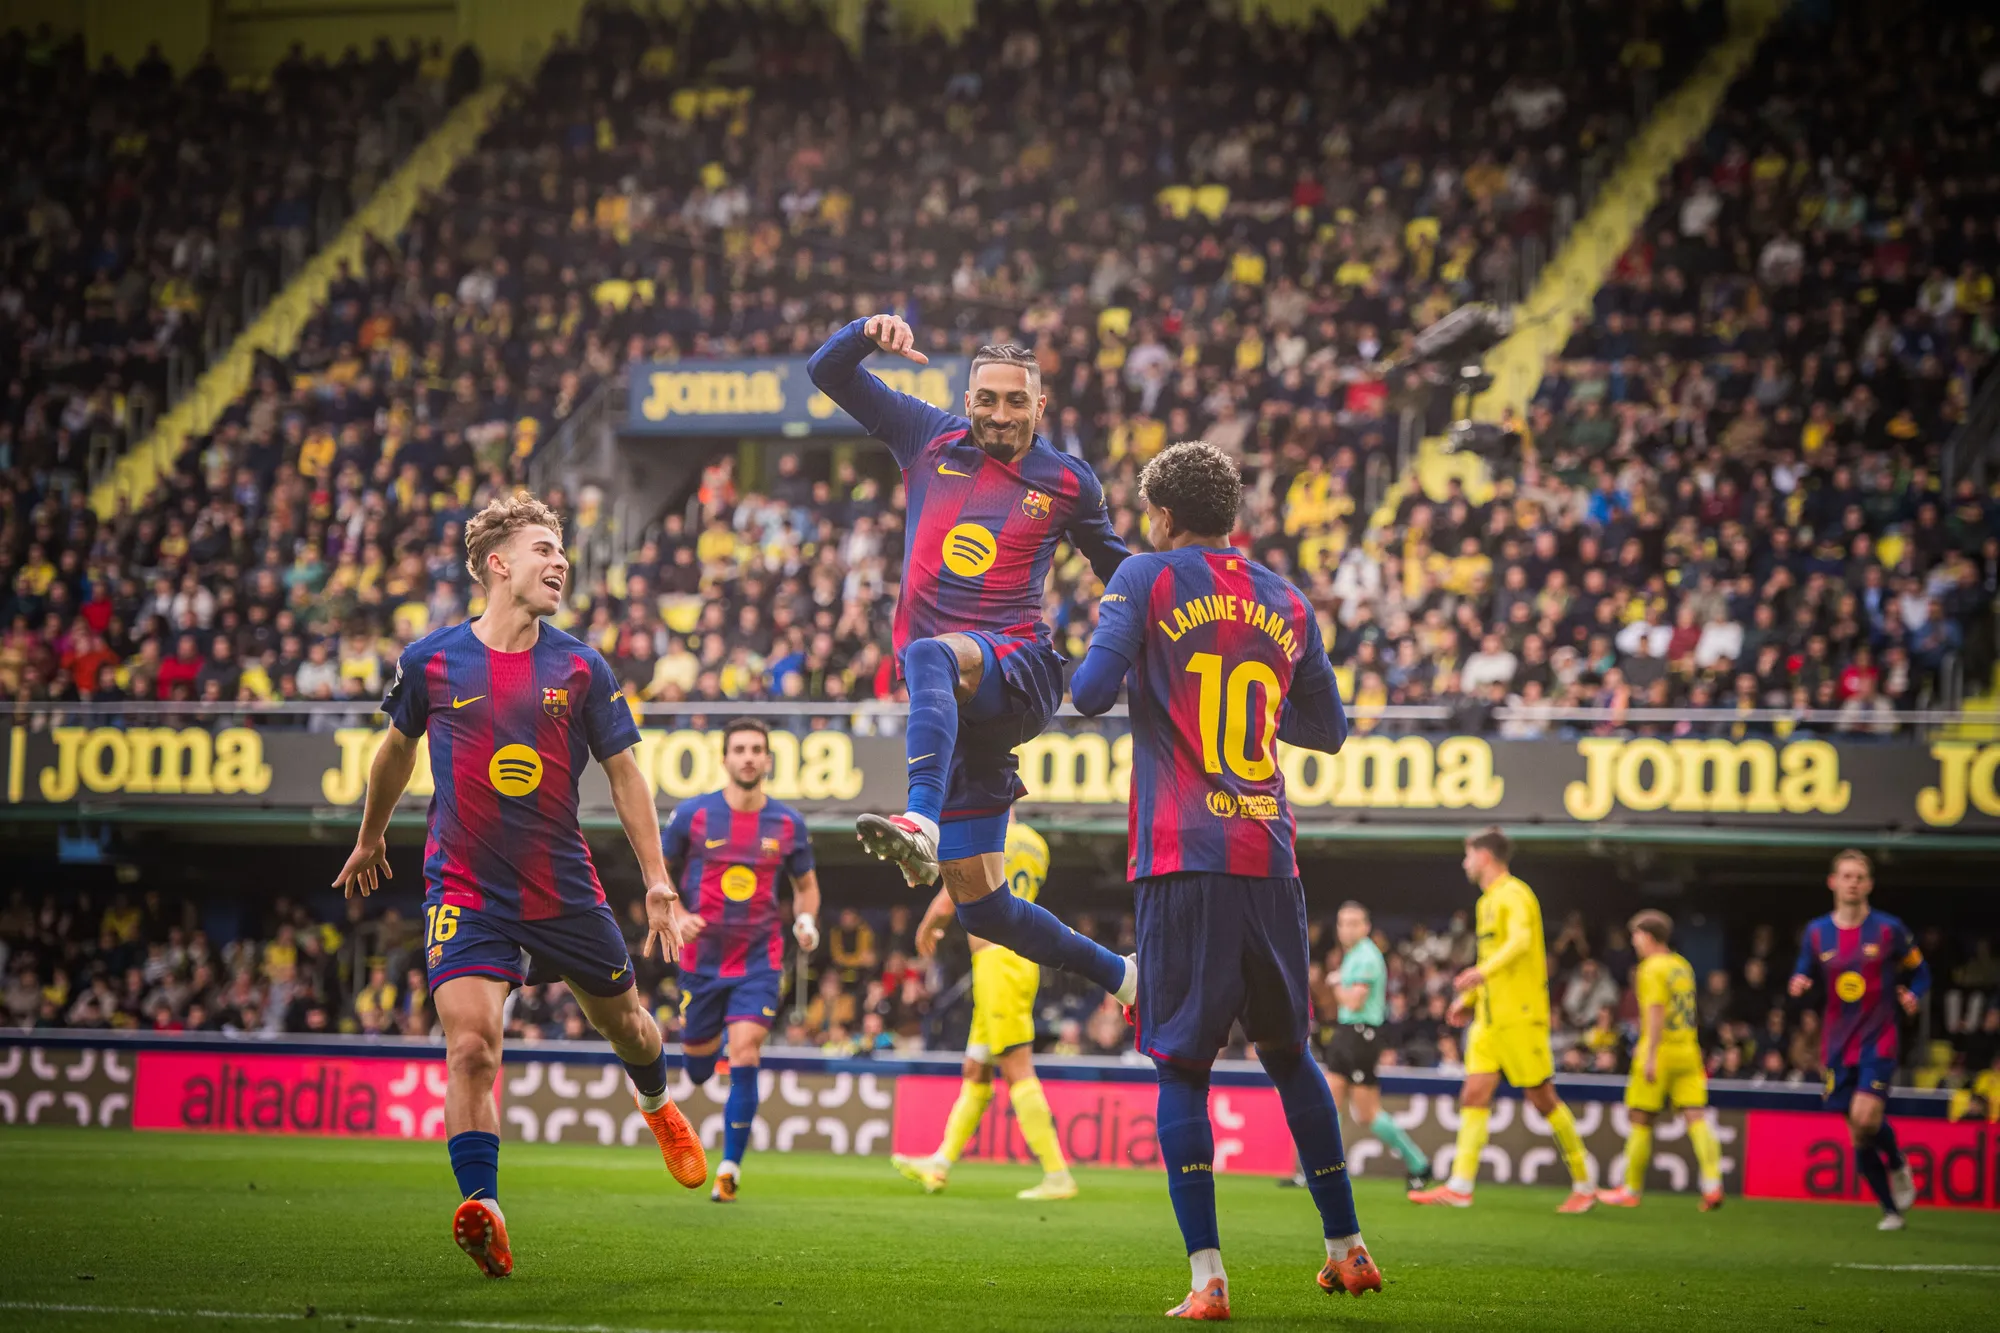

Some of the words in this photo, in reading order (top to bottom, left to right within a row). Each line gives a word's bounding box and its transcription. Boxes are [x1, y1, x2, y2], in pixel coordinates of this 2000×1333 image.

[1158, 594, 1237, 642] LAMINE
[1242, 599, 1298, 662] YAMAL
[1185, 652, 1281, 781] 10
[1237, 794, 1278, 806] UNHCR
[1277, 735, 1504, 809] oma
[1240, 804, 1279, 816] ACNUR
[427, 903, 461, 949] 16
[181, 1064, 378, 1133] altadia
